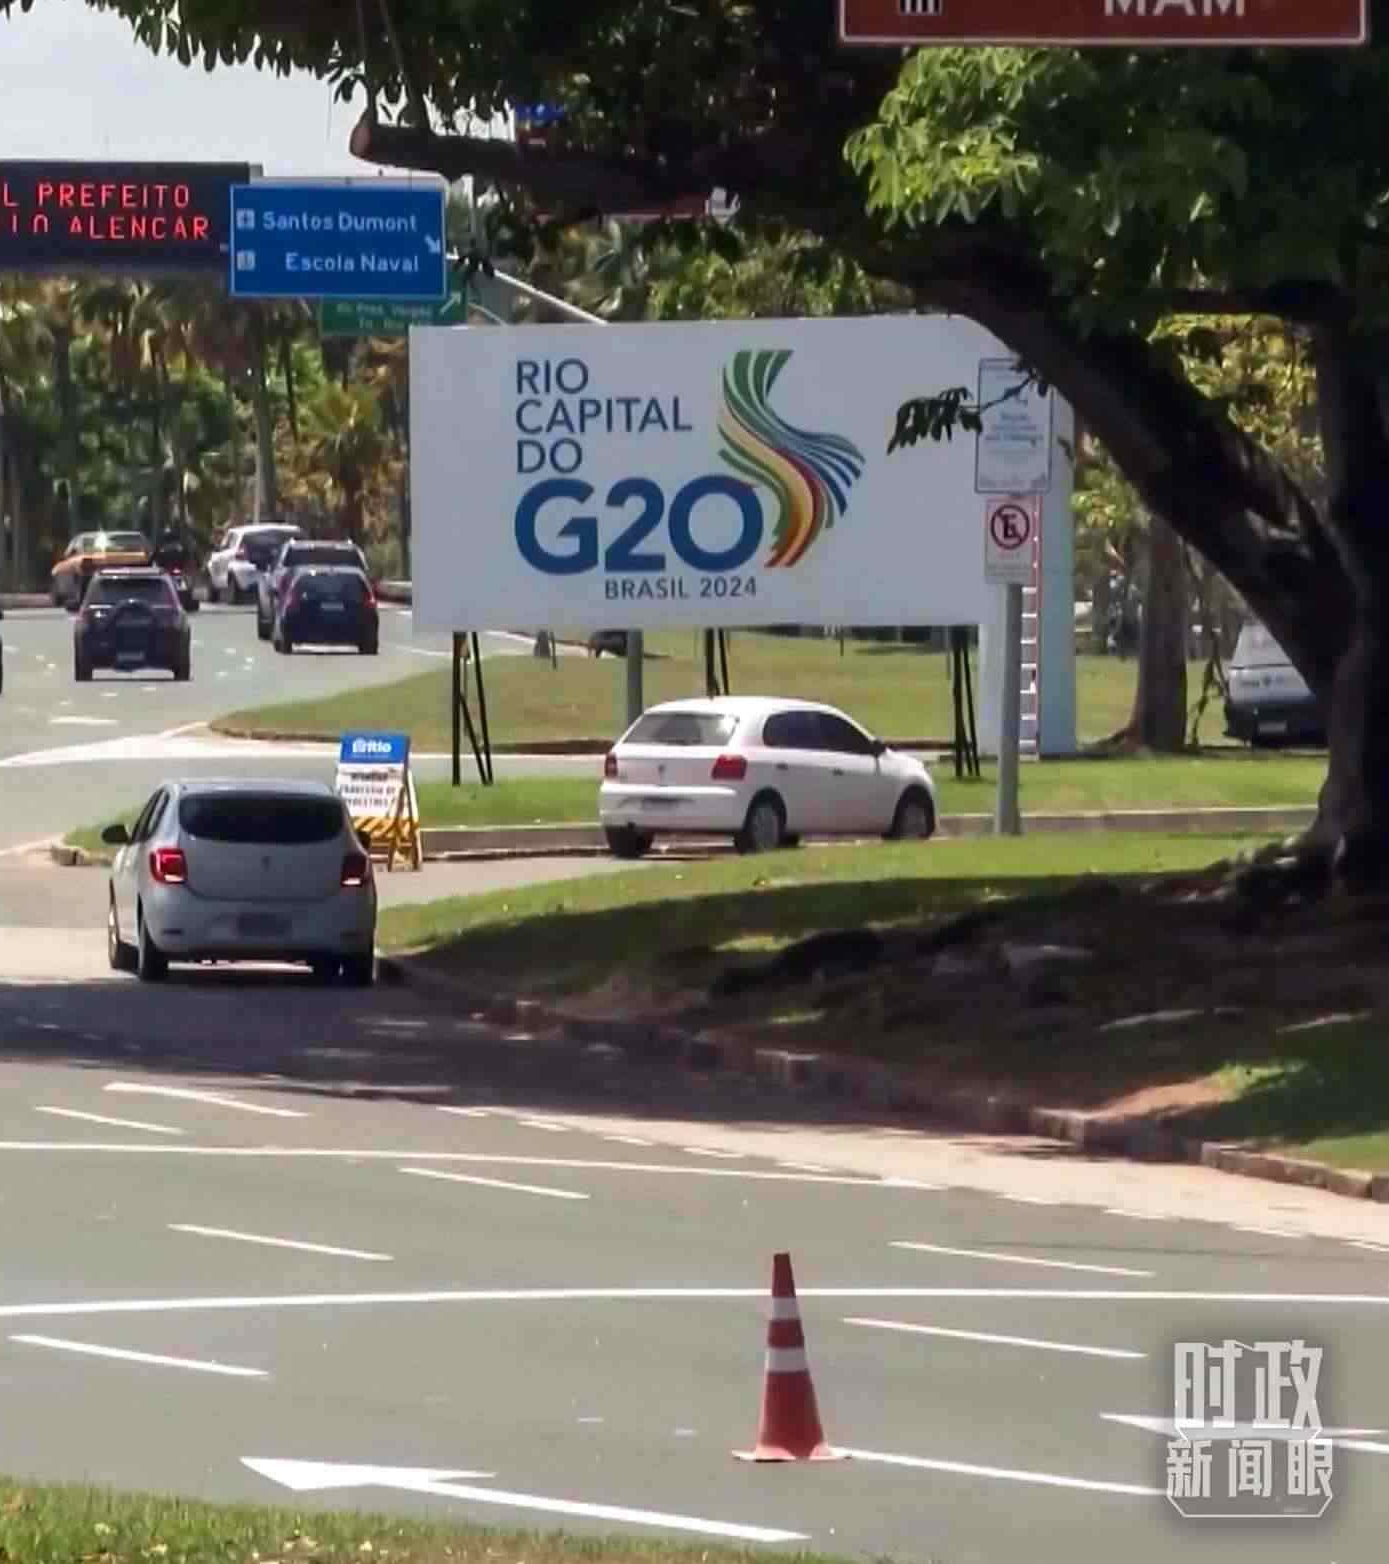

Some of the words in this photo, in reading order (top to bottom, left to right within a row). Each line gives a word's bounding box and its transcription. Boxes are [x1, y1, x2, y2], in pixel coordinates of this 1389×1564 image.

[37, 182, 189, 209] PREFEITO
[69, 215, 208, 240] ALENCAR
[263, 211, 334, 232] Santos
[339, 211, 418, 232] Dumont
[285, 252, 355, 272] Escola
[360, 252, 420, 273] Naval
[516, 358, 589, 394] RIO
[515, 397, 693, 435] CAPITAL
[517, 438, 584, 474] DO
[513, 473, 765, 575] G20
[604, 577, 690, 601] BRASIL
[699, 576, 758, 599] 2024
